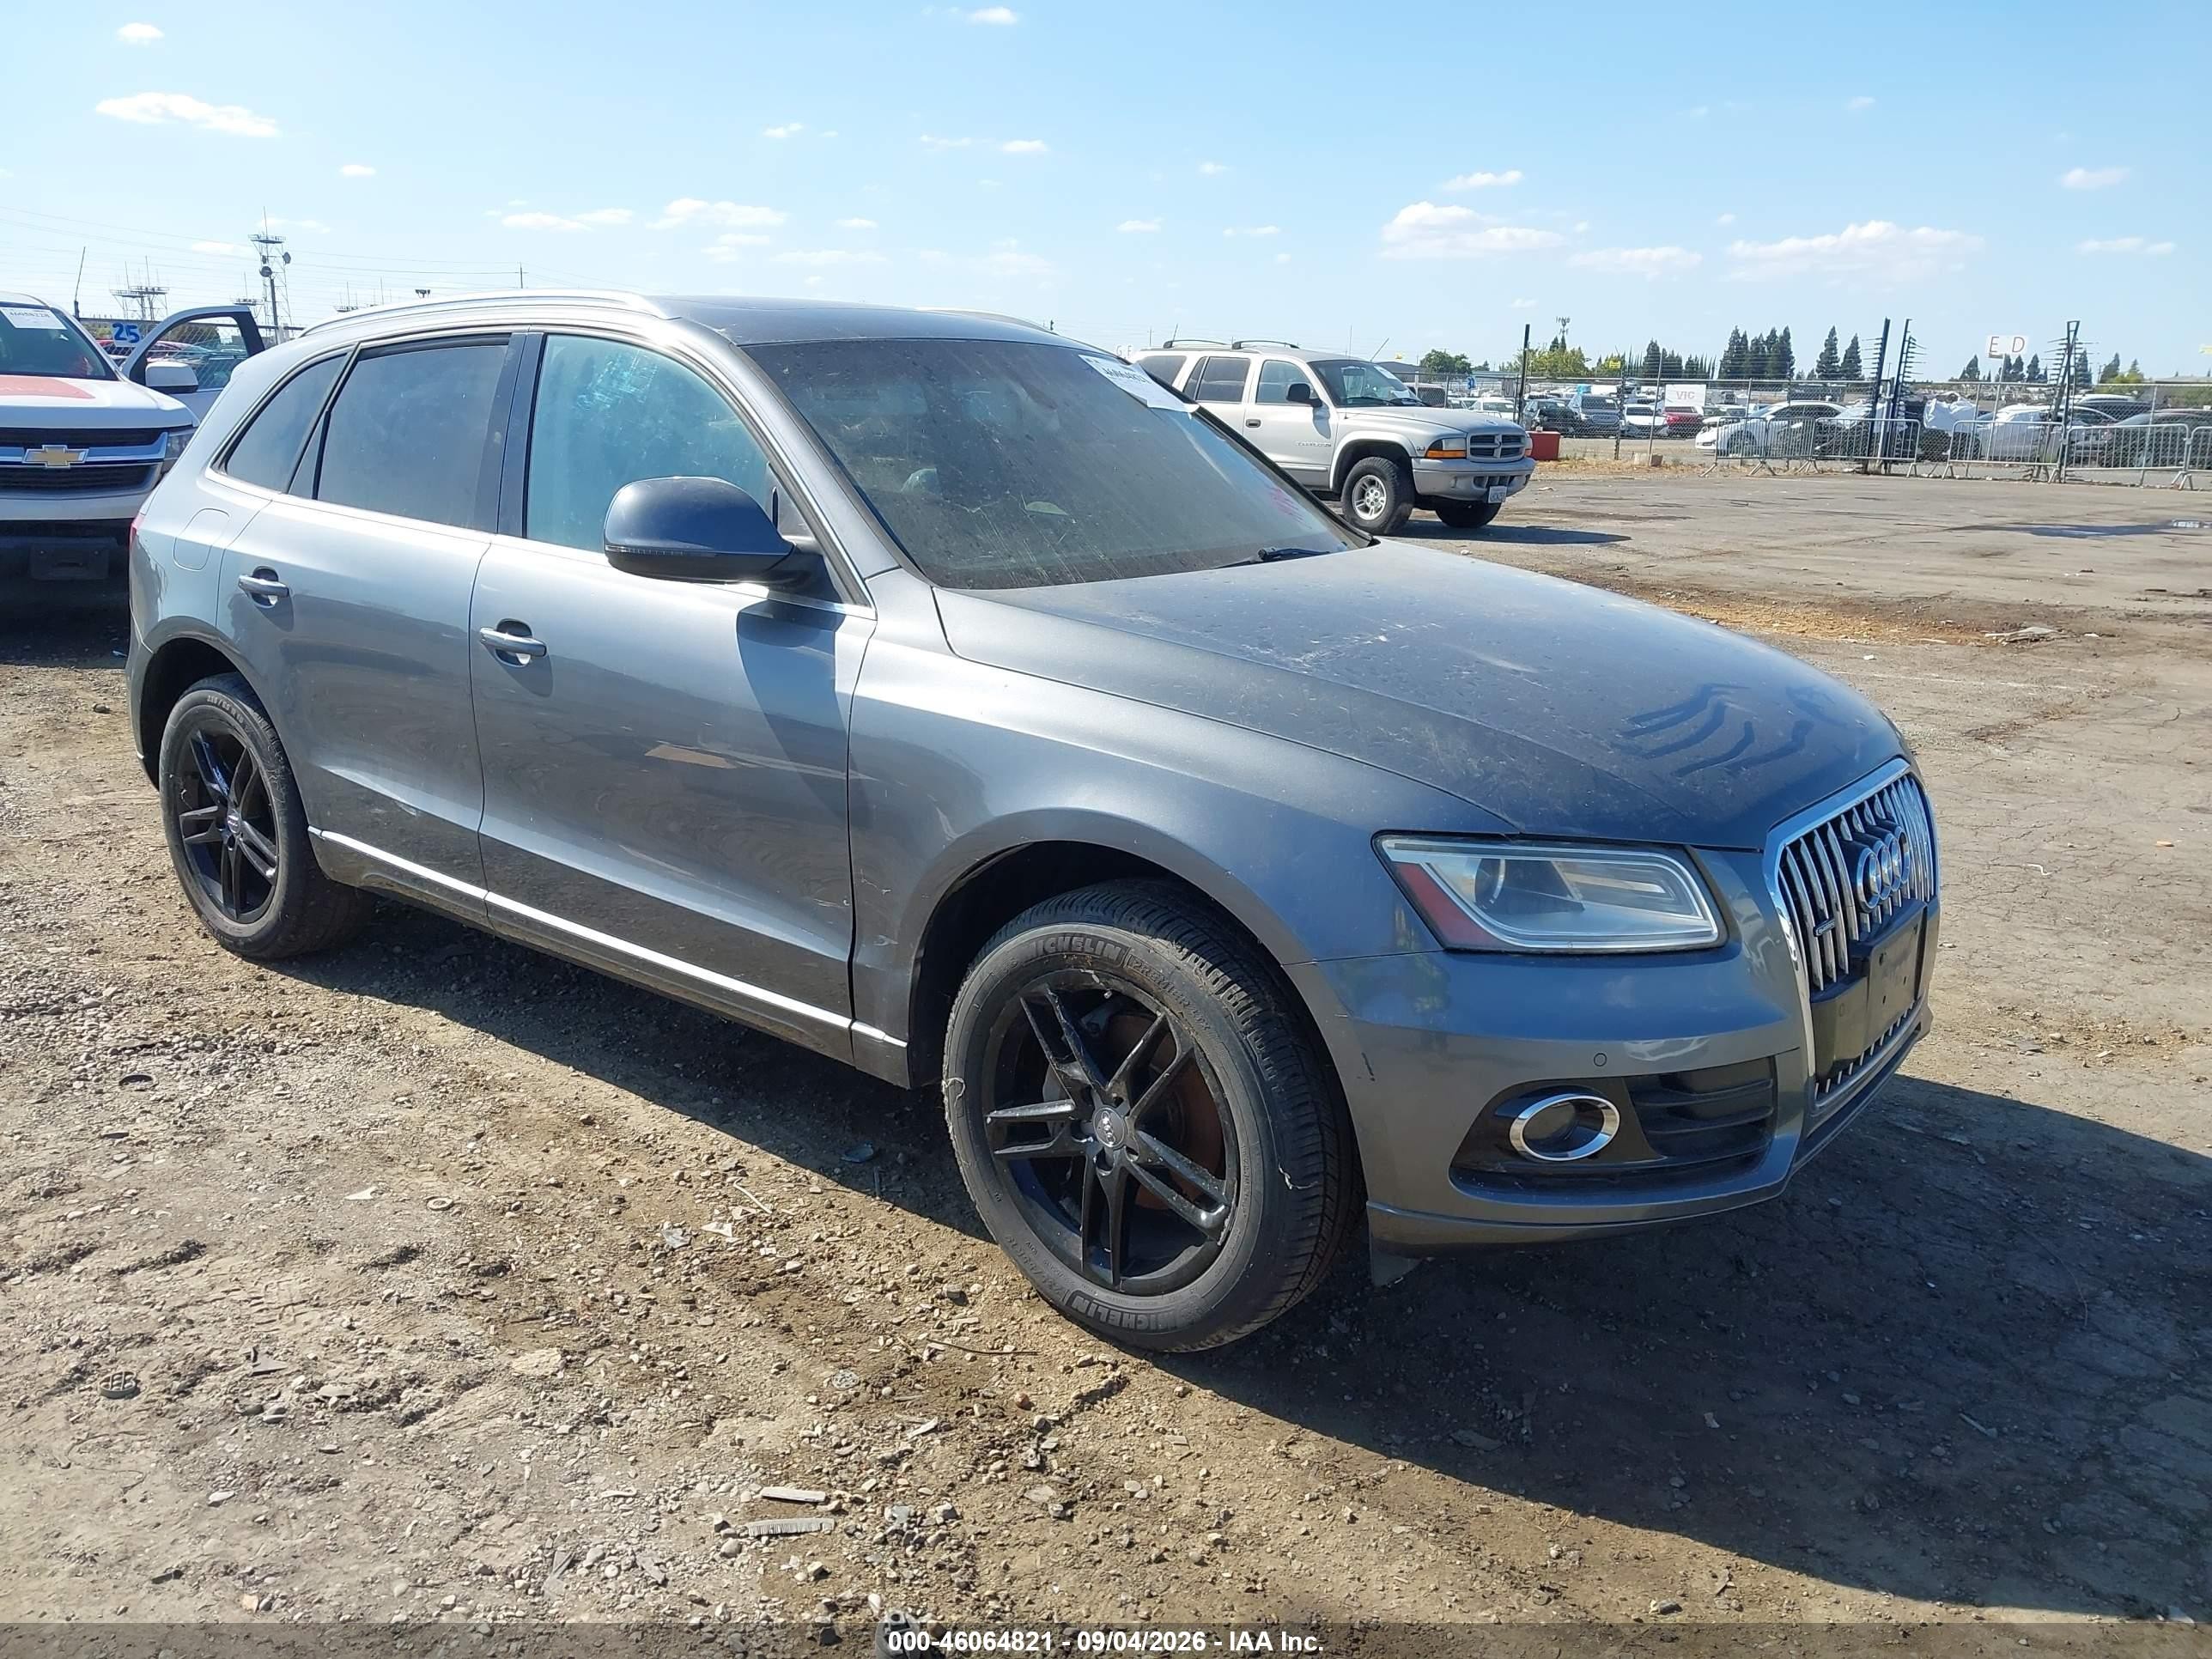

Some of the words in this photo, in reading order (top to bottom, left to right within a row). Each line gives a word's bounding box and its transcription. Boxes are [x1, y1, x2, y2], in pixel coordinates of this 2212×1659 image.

[112, 322, 140, 343] 25
[1989, 336, 2000, 353] E
[2012, 336, 2026, 353] D
[1675, 391, 1696, 400] VIC
[1019, 935, 1123, 963] MICHELIN
[1071, 1295, 1174, 1331] MICHELIN
